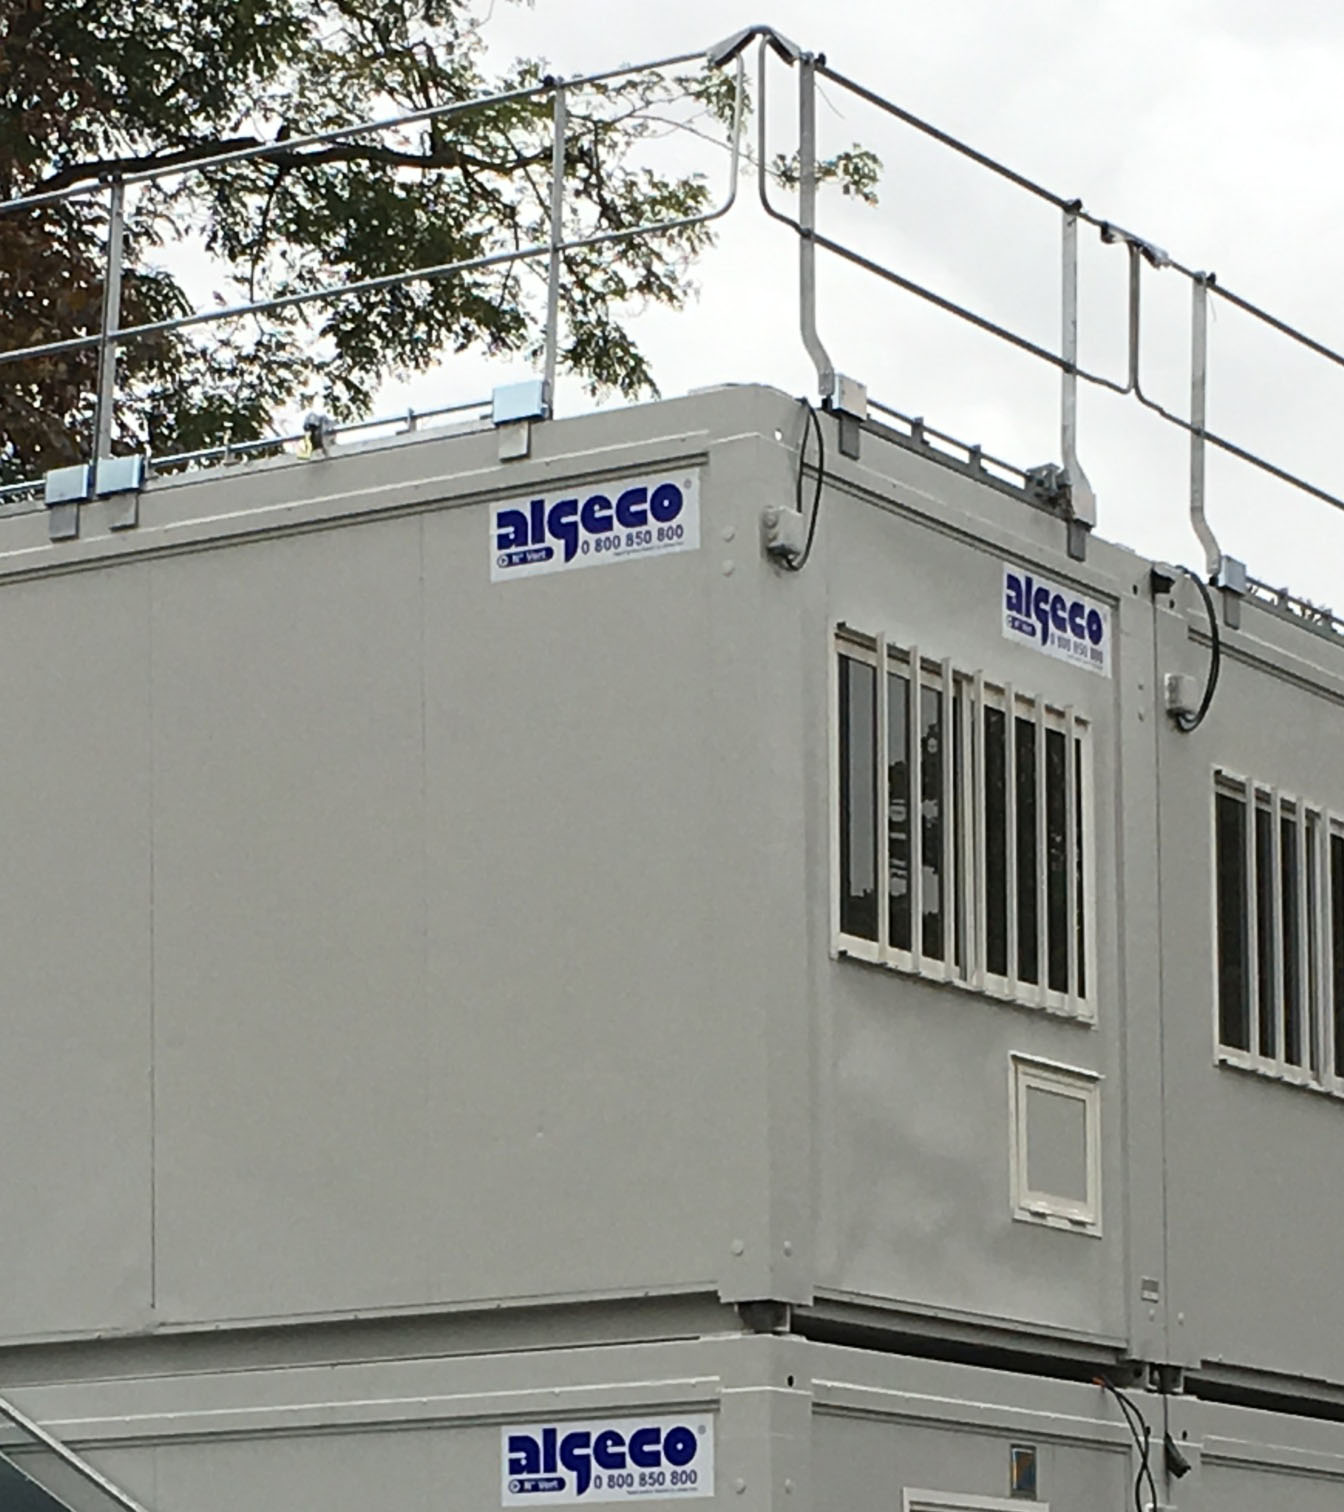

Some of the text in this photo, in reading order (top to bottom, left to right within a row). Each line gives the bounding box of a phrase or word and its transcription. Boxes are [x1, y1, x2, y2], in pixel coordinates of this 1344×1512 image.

[497, 483, 683, 563] algeco
[581, 540, 589, 555] 0
[594, 535, 621, 553] 800
[625, 530, 652, 548] 850
[657, 524, 684, 542] 800
[1006, 573, 1103, 646] algeco
[508, 1426, 697, 1497] algeco
[594, 1470, 697, 1489] 0 800 850 800
